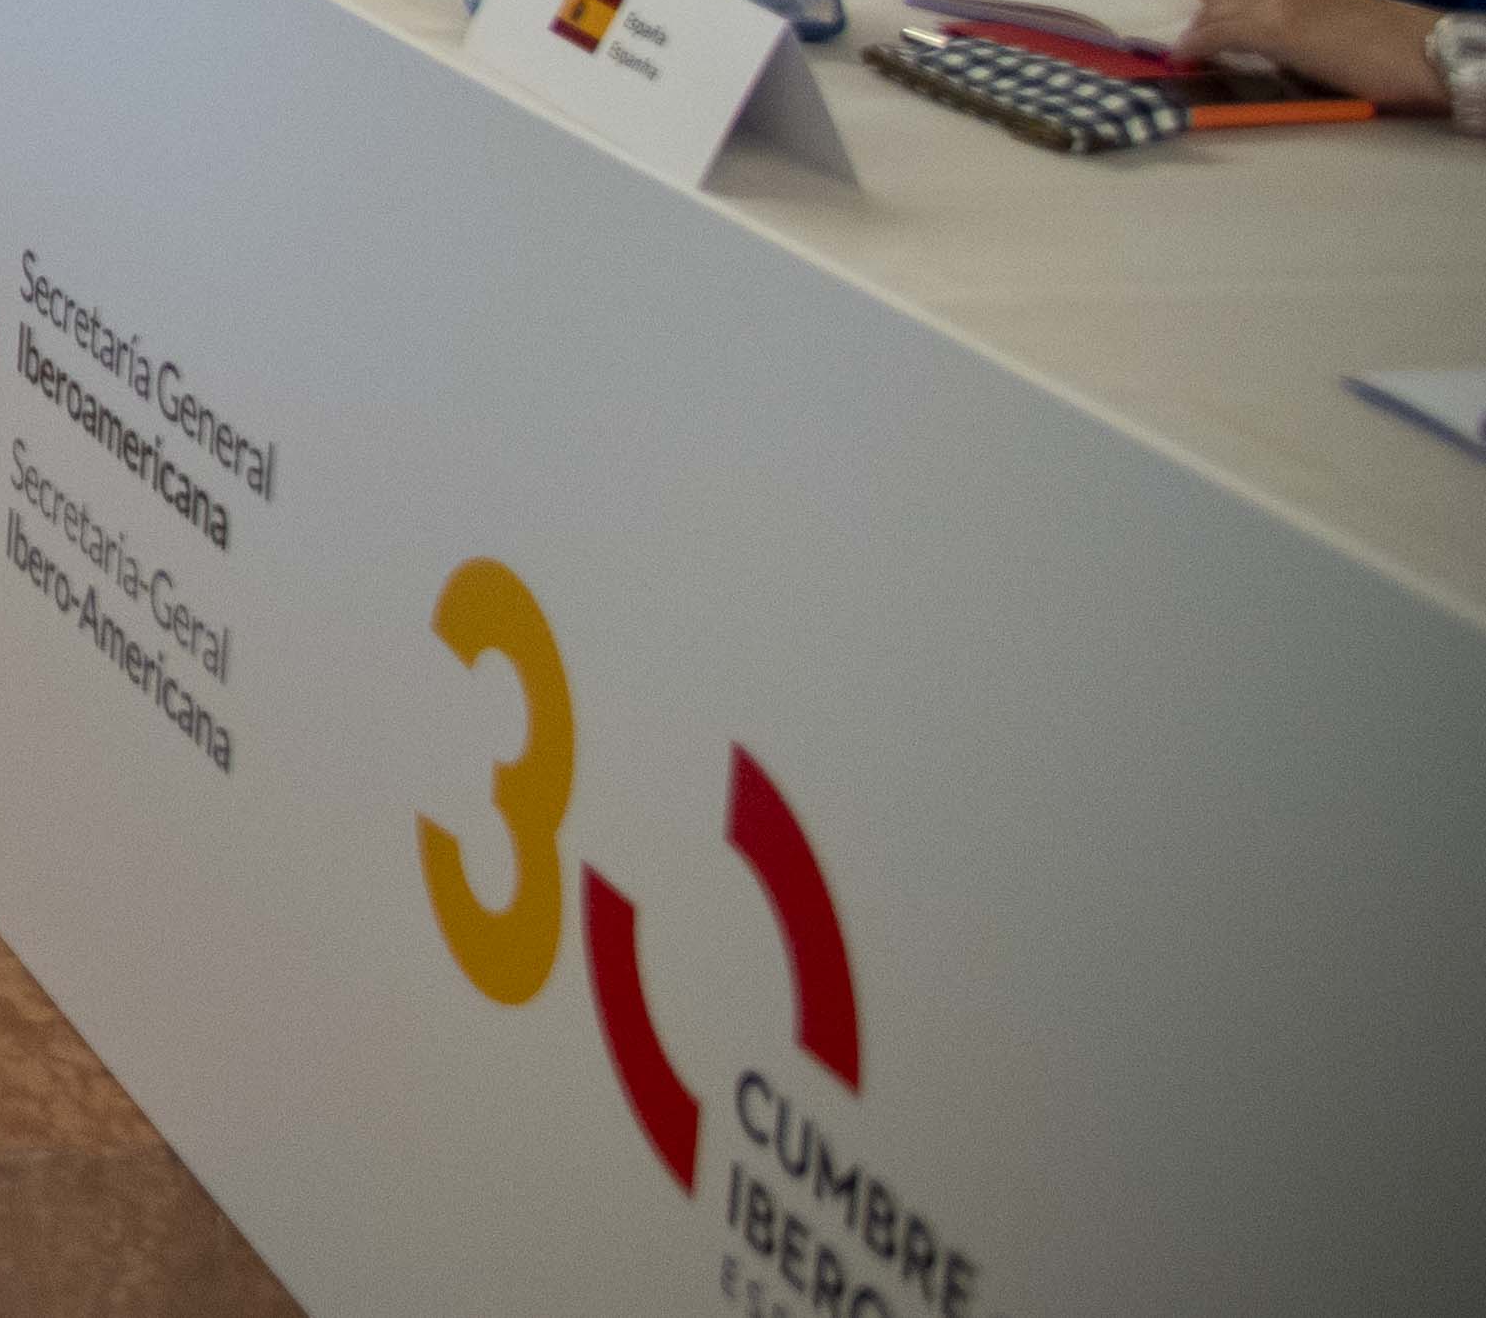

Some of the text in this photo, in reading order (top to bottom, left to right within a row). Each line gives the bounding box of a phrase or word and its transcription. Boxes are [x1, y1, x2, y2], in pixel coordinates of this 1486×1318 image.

[17, 320, 230, 551] Iberoamericana
[19, 247, 277, 502] Secretaría General
[6, 507, 233, 774] Ibero-Americana
[10, 438, 231, 684] Secretaria-Geral
[735, 1069, 979, 1318] CUMBRE
